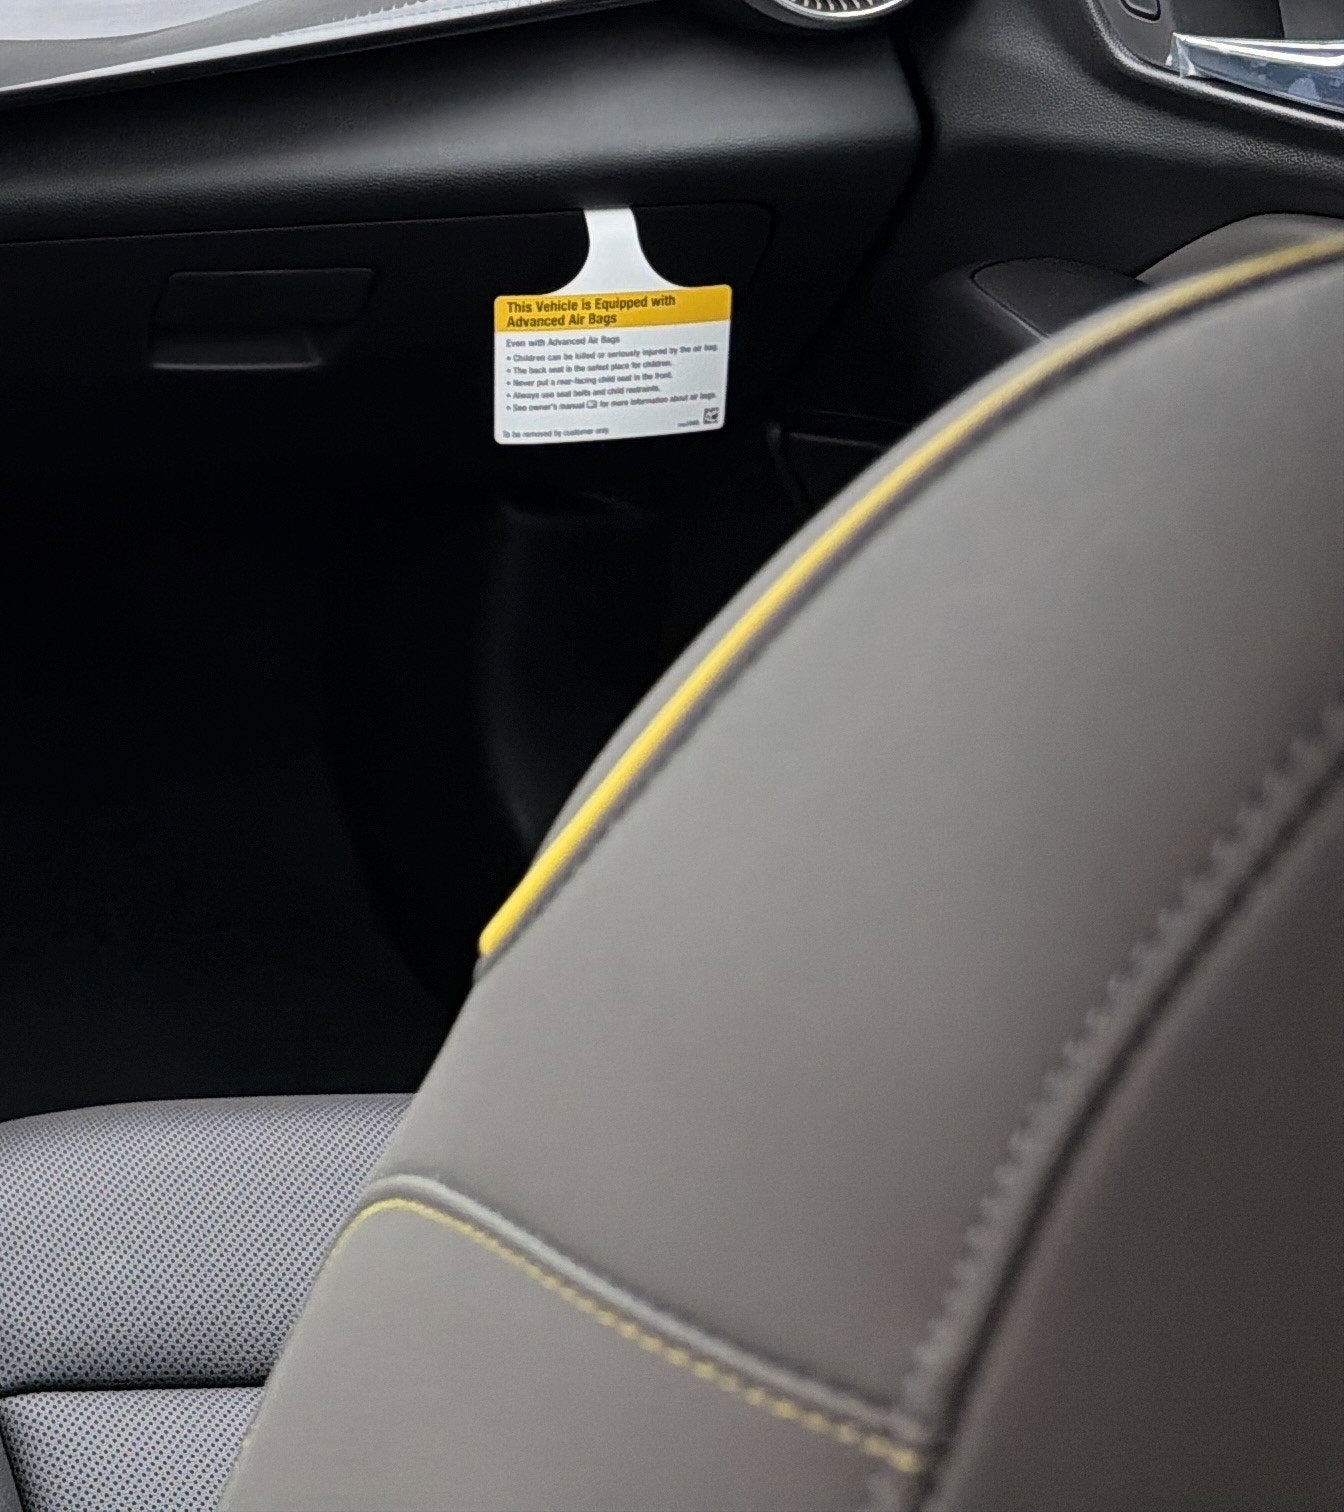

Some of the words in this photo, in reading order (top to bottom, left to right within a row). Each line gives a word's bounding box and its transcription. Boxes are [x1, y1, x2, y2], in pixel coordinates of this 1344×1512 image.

[507, 301, 532, 313] This
[535, 299, 578, 313] Vehicle
[581, 298, 591, 311] is
[594, 295, 648, 313] Equipped
[651, 295, 676, 307] with
[507, 314, 565, 328] Advanced
[568, 313, 586, 326] Air
[588, 312, 617, 326] Bags
[506, 338, 526, 348] Even
[528, 338, 545, 347] with
[547, 337, 586, 346] Advanced
[588, 336, 598, 344] Air
[601, 335, 620, 345] Bags
[513, 354, 546, 363] Children
[547, 354, 561, 362] can
